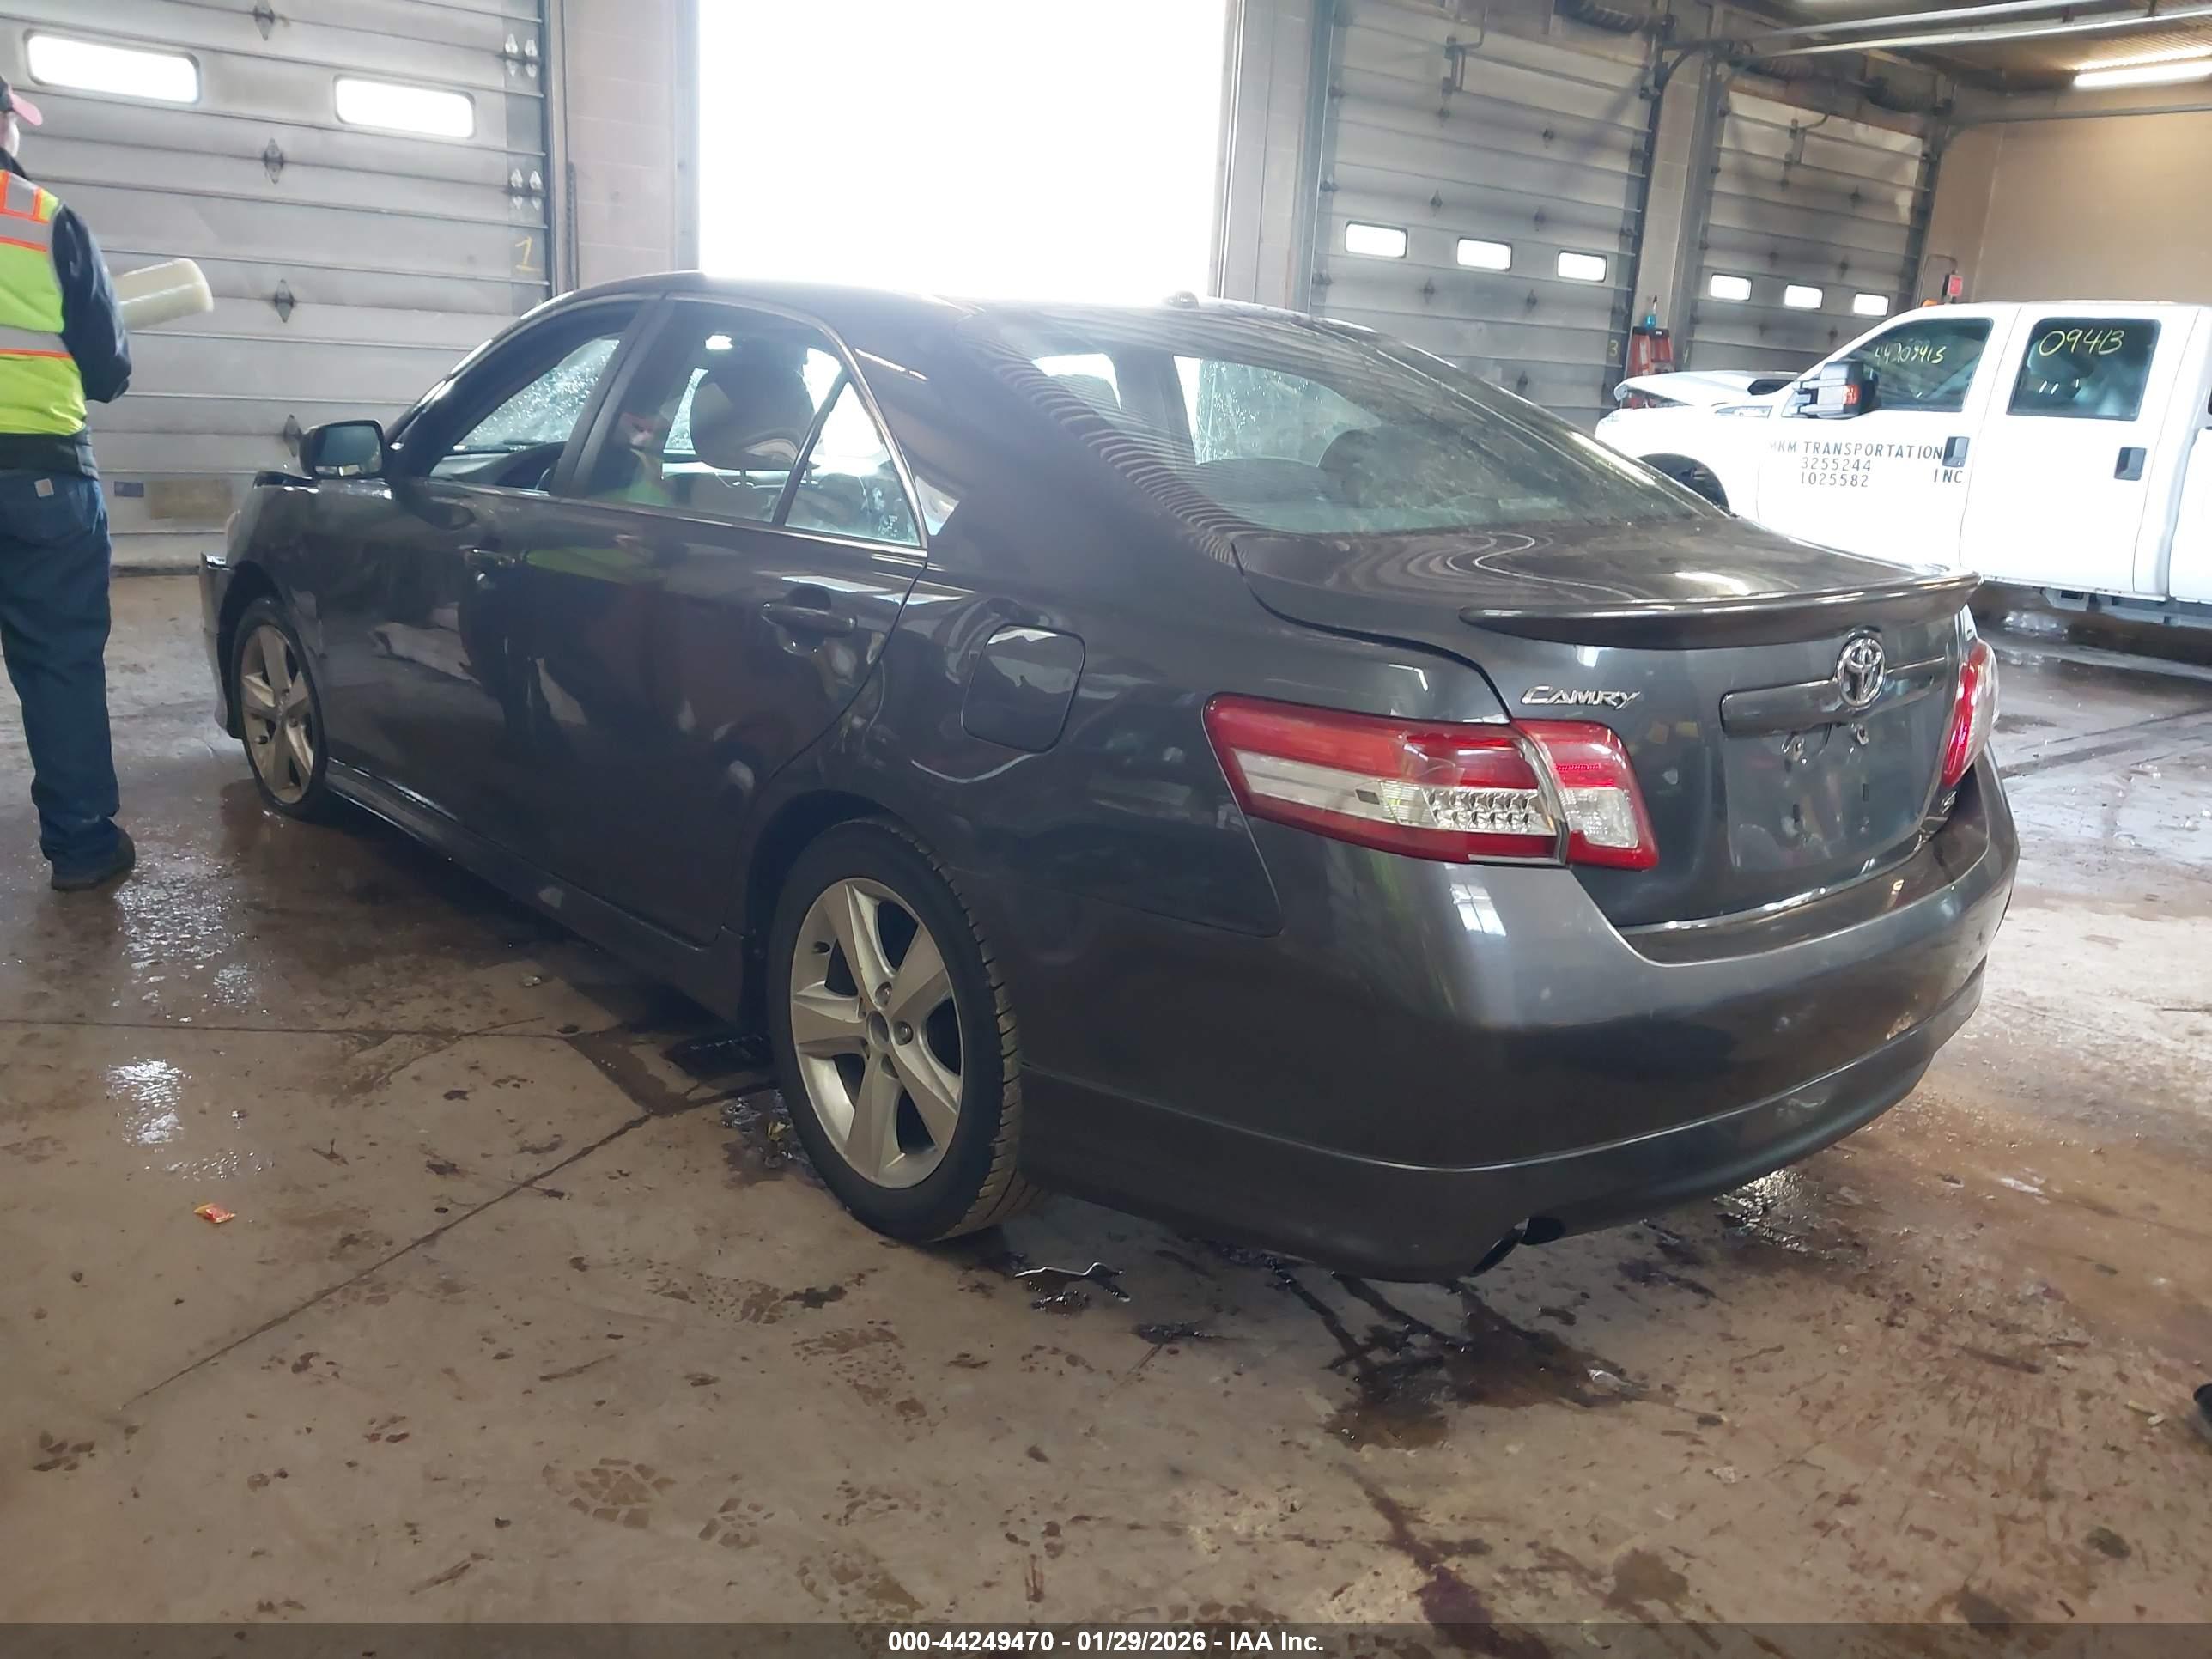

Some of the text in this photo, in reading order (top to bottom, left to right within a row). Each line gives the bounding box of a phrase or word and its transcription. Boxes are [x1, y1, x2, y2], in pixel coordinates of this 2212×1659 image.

[515, 235, 542, 271] 1
[1609, 339, 1619, 357] 3
[1804, 441, 1943, 459] TRANSPORTATION
[1801, 457, 1872, 472] 3255244
[1800, 472, 1869, 487] 1025582
[1933, 469, 1963, 483] INC
[1522, 685, 1640, 710] CAMRY
